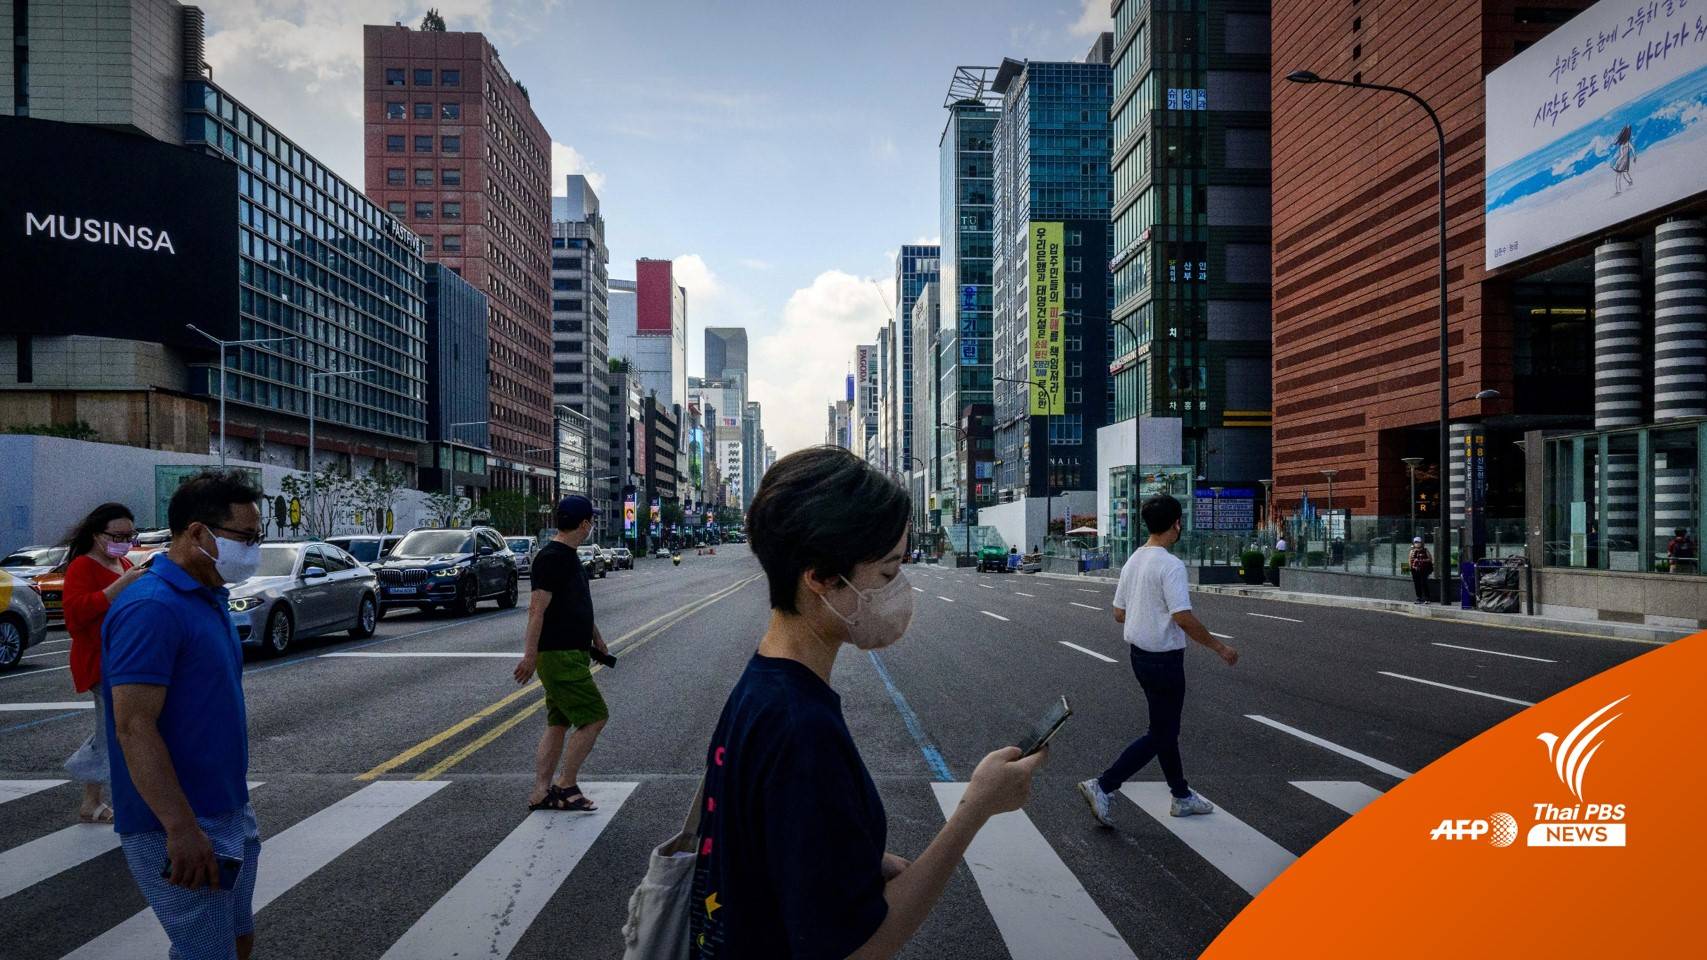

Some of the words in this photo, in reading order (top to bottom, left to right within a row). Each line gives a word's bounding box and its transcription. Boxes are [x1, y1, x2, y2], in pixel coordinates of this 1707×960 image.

[1582, 36, 1594, 60] 두
[1597, 25, 1618, 54] 눈에
[1533, 92, 1570, 128] 시작도
[1573, 74, 1599, 108] 끝도
[1603, 57, 1629, 91] 없는
[1636, 21, 1689, 72] 바다가
[26, 212, 176, 255] MUSINSA
[1036, 228, 1047, 282] 우리은행과
[1049, 243, 1059, 303] 입주민들의
[1036, 285, 1047, 338] 태영건설은
[1049, 345, 1060, 405] 책임져라!
[1050, 457, 1080, 465] NAIL
